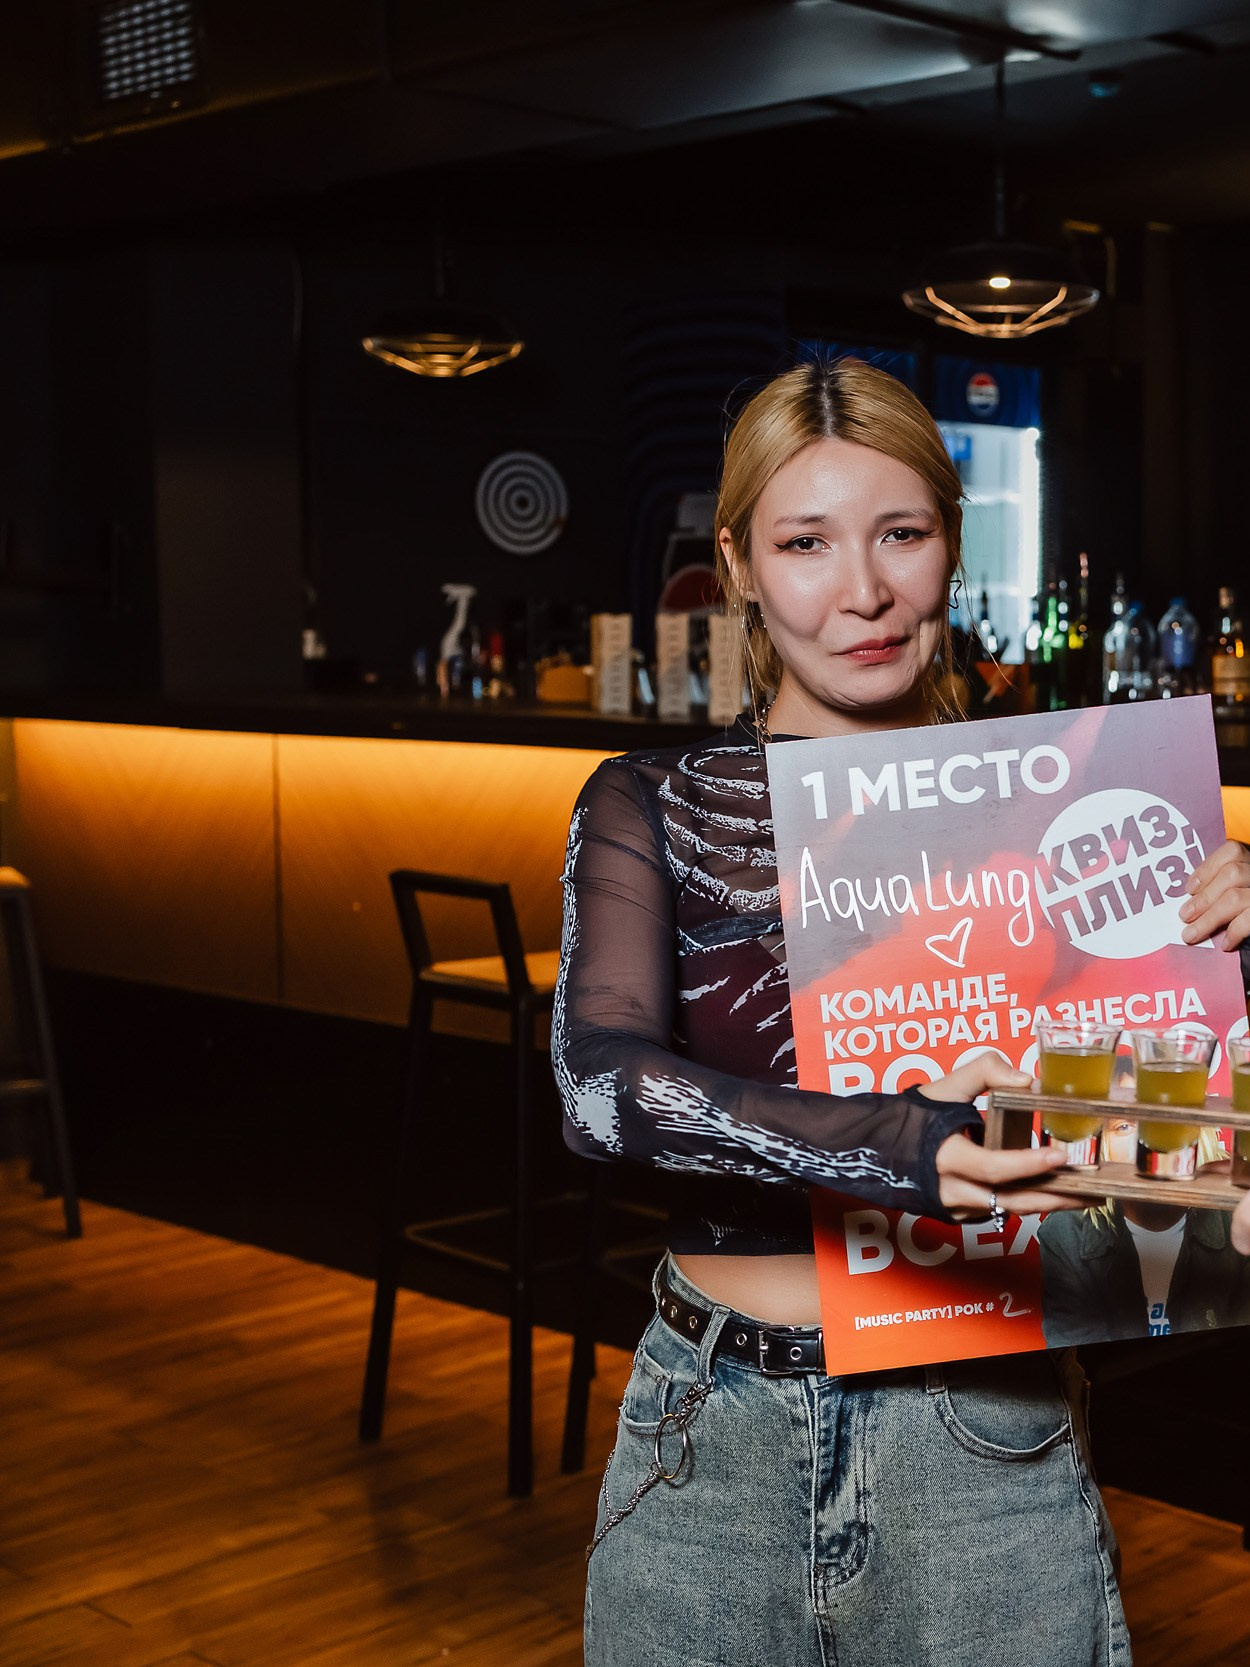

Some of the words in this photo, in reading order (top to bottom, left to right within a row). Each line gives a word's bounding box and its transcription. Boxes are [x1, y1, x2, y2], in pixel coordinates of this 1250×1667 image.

[801, 772, 828, 820] 1
[848, 745, 1070, 816] МЕСТО
[1042, 805, 1195, 893] КВИЗ,
[820, 973, 1018, 1023] КОМАНДЕ,
[823, 1010, 999, 1060] КОТОРАЯ
[1009, 988, 1206, 1038] РАЗНЕСЛА
[854, 1313, 903, 1331] [MUSIC
[905, 1305, 952, 1323] PARTY]
[954, 1302, 983, 1317] РОК
[999, 1292, 1032, 1317] 2
